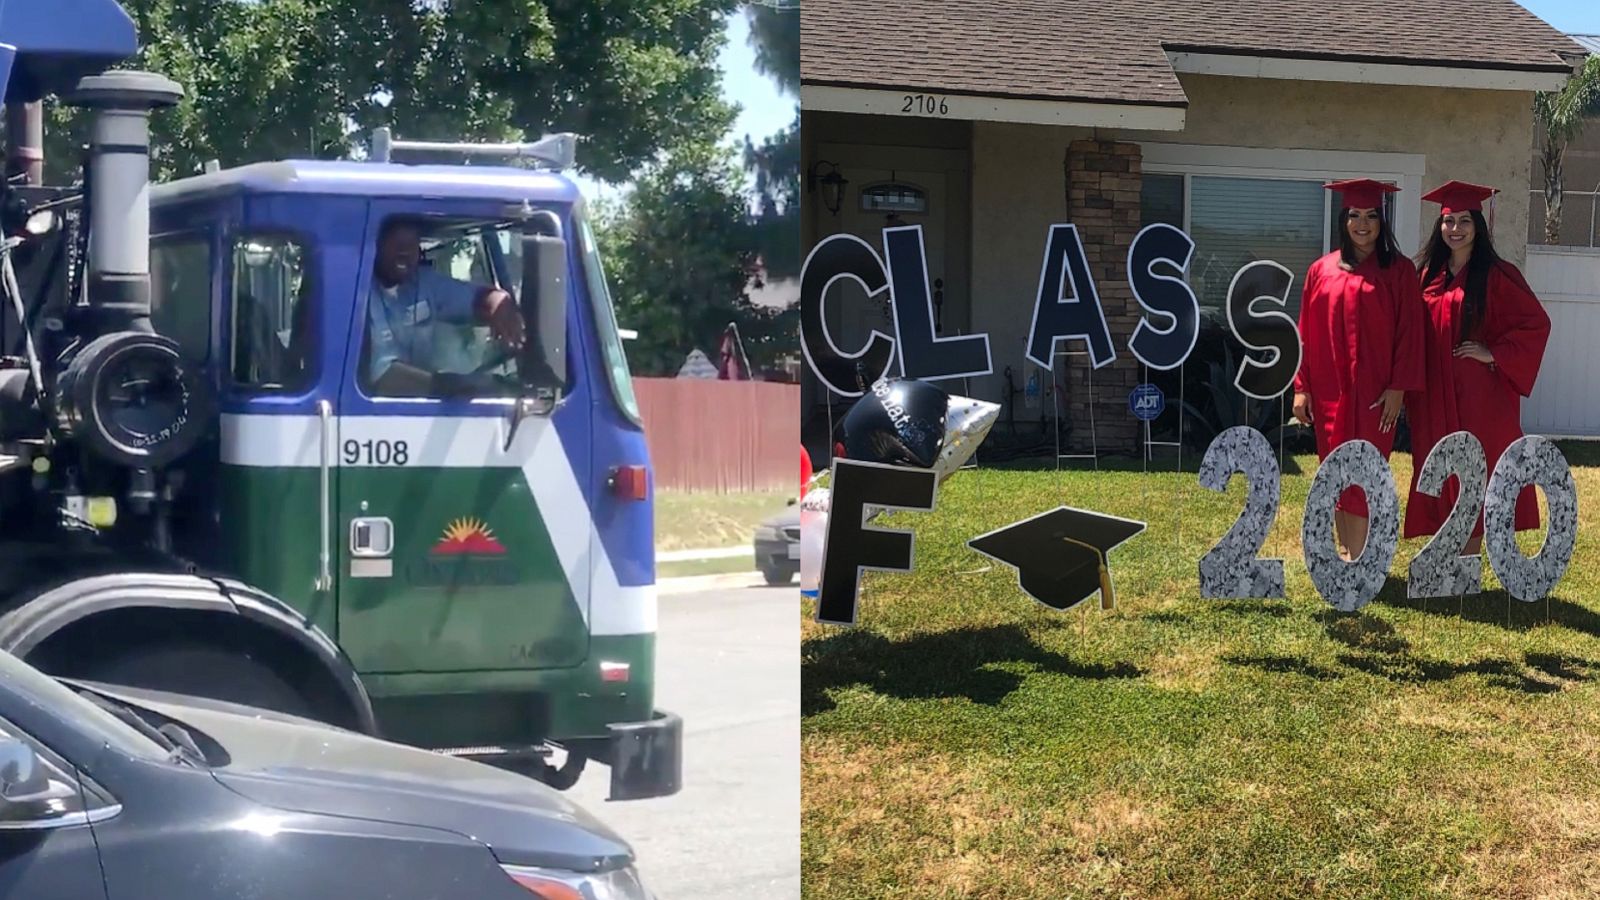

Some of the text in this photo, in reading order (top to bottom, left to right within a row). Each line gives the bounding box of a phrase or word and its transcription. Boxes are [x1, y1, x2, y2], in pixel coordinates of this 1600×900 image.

[800, 223, 1304, 399] CLASS
[344, 439, 409, 465] 9108
[1135, 395, 1160, 409] ADT
[1199, 425, 1578, 612] 2020
